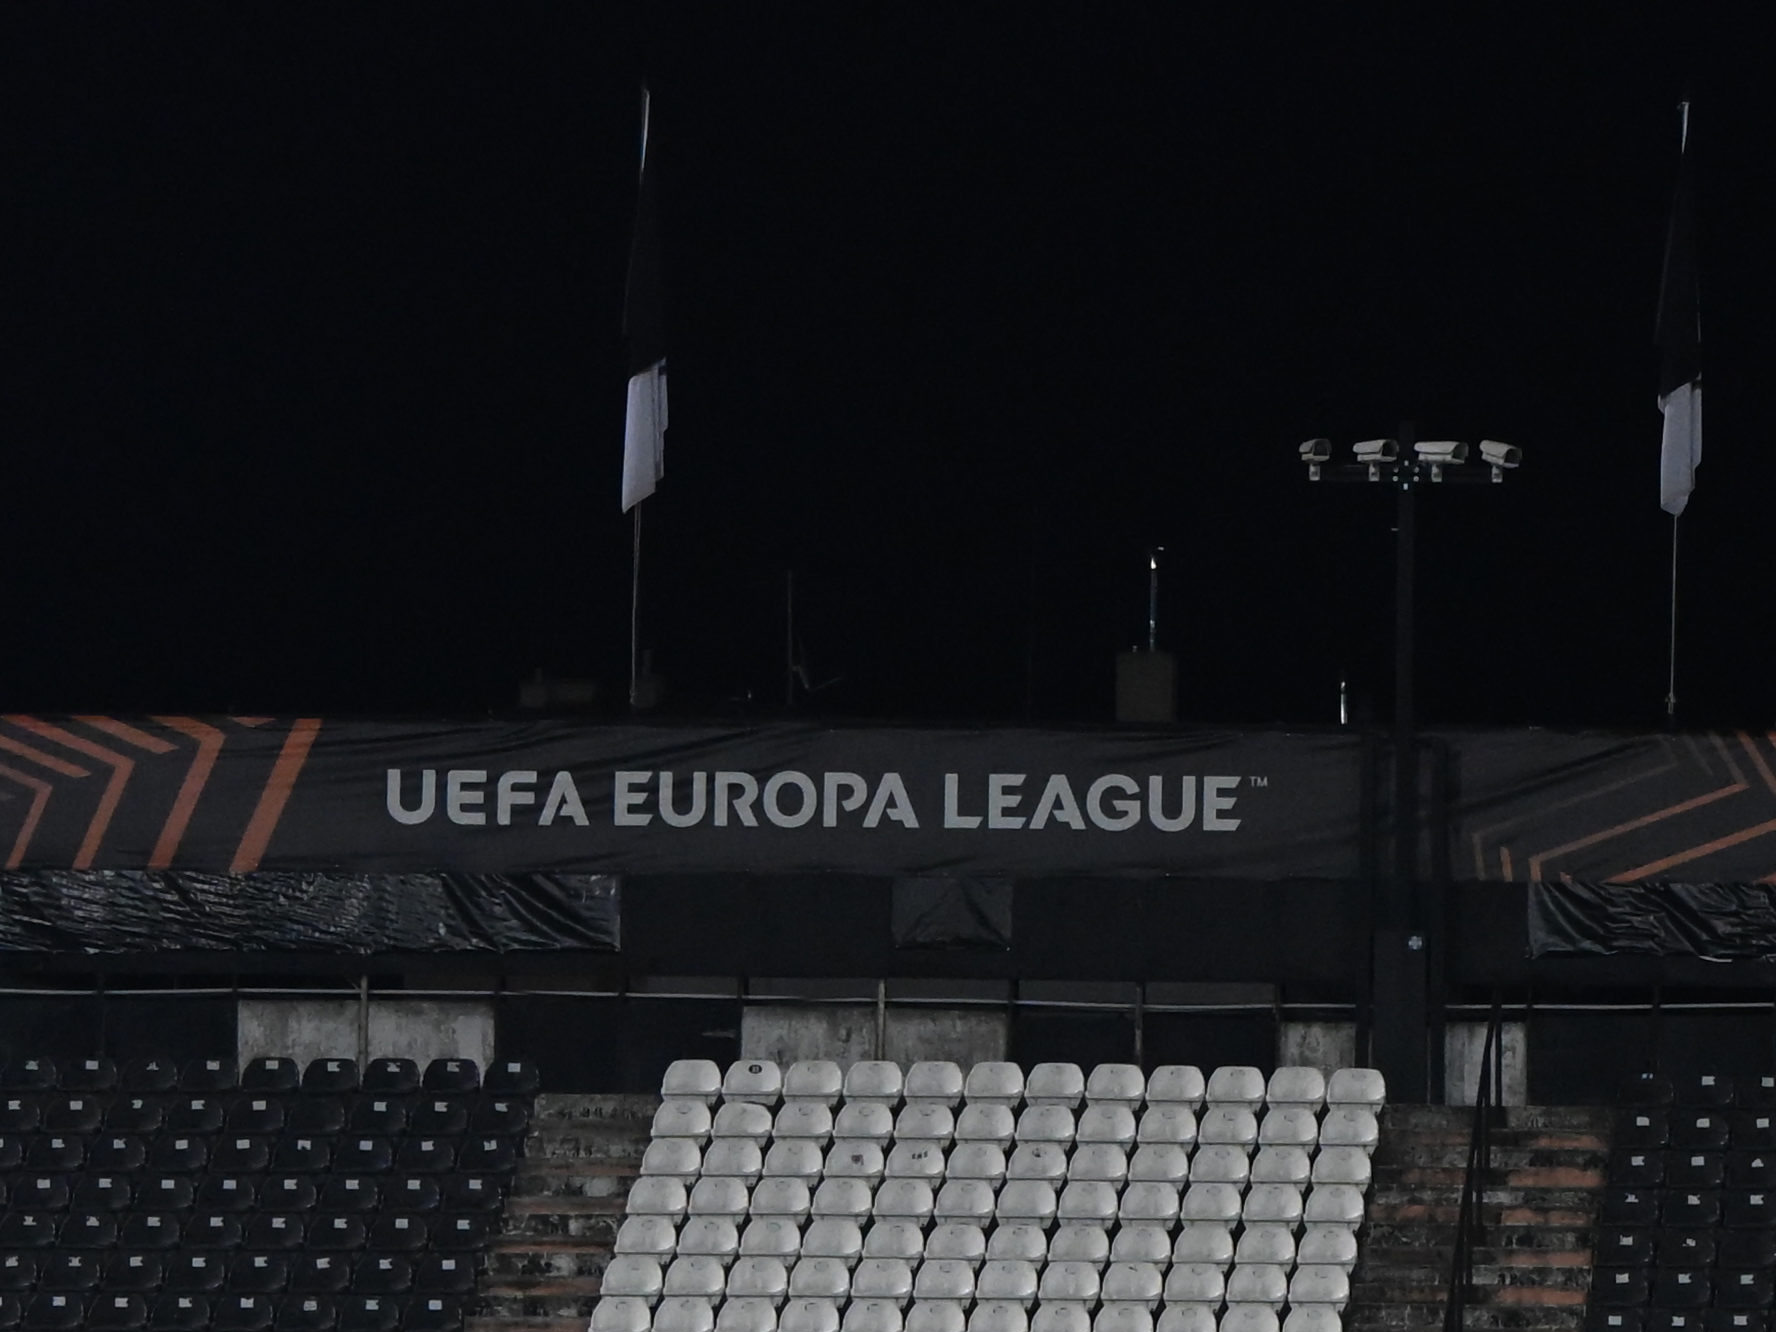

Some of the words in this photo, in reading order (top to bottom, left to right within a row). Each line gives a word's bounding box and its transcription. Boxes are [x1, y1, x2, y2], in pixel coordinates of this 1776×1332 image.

[386, 768, 590, 826] UEFA
[614, 770, 920, 828] EUROPA
[943, 773, 1242, 832] LEAGUE
